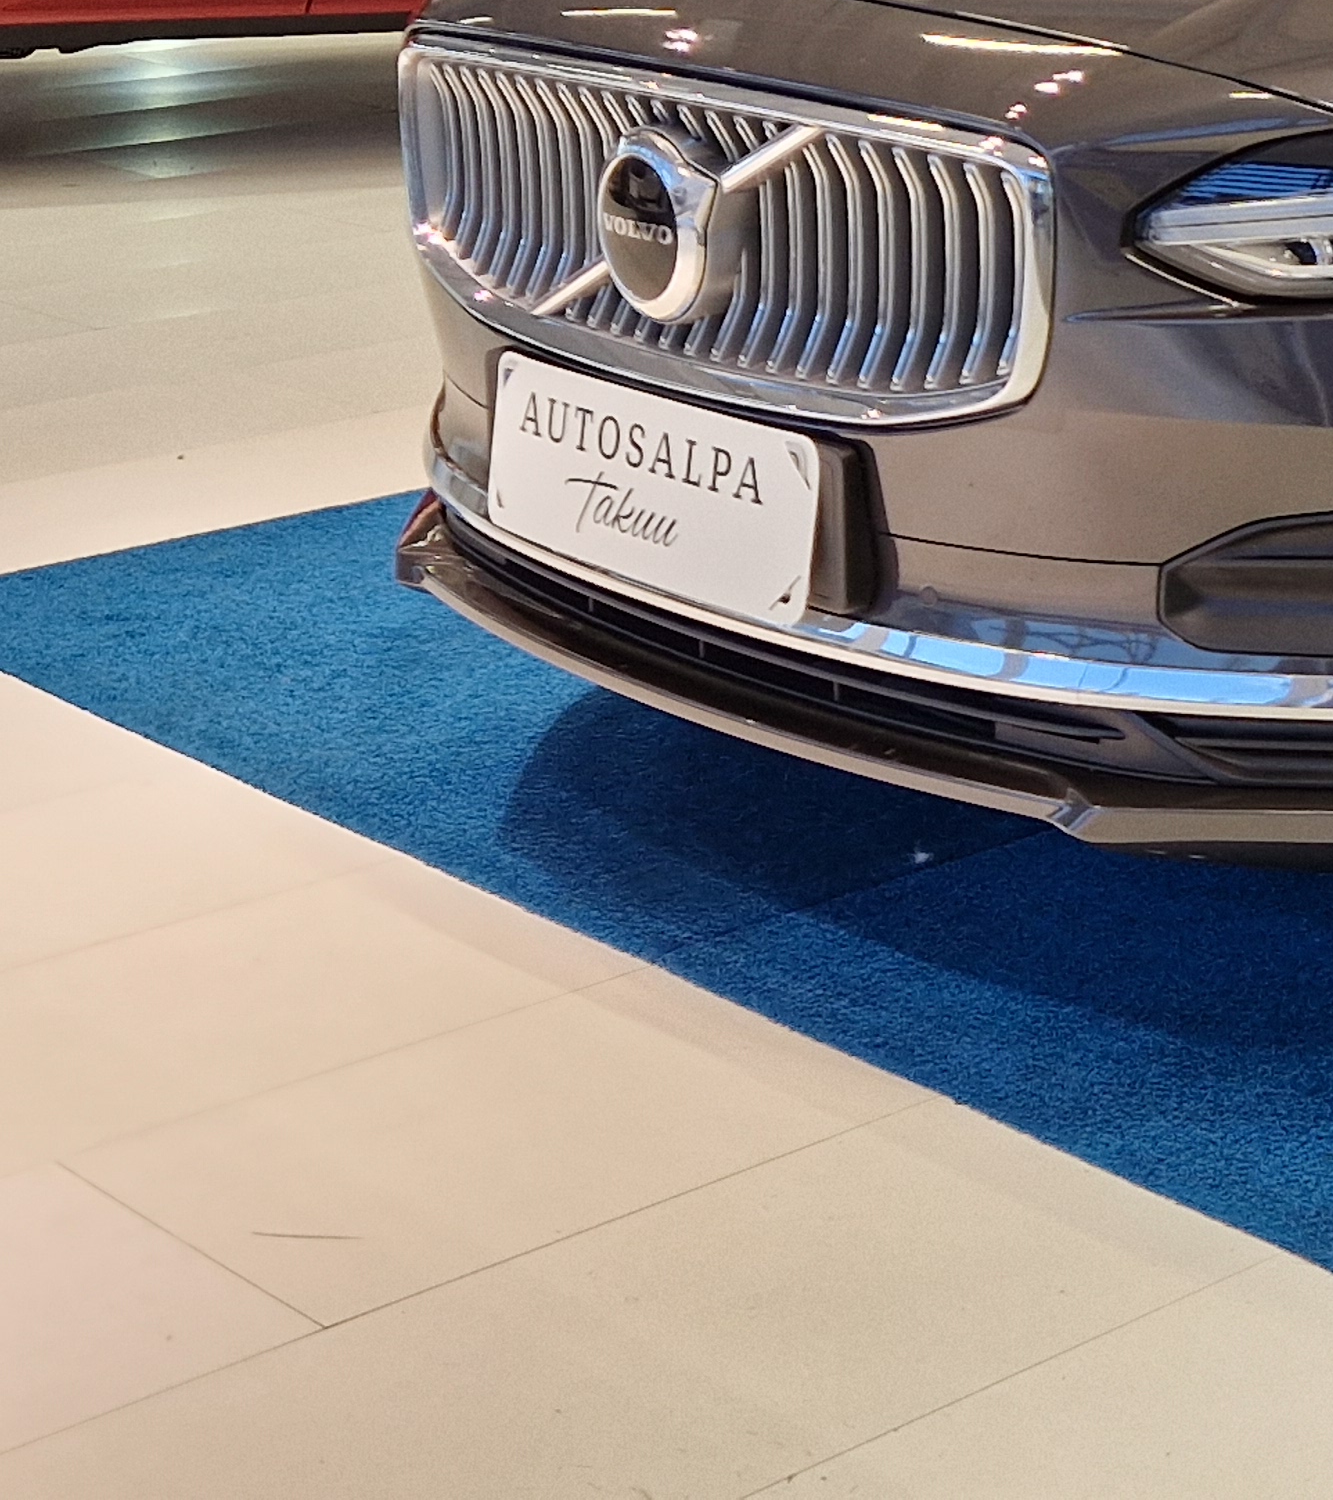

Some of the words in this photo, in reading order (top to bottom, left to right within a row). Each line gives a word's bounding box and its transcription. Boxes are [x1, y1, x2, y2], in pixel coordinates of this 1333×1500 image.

[603, 212, 673, 245] VOLVO
[519, 392, 763, 505] AUTOSALPA
[565, 471, 679, 547] Takuu
